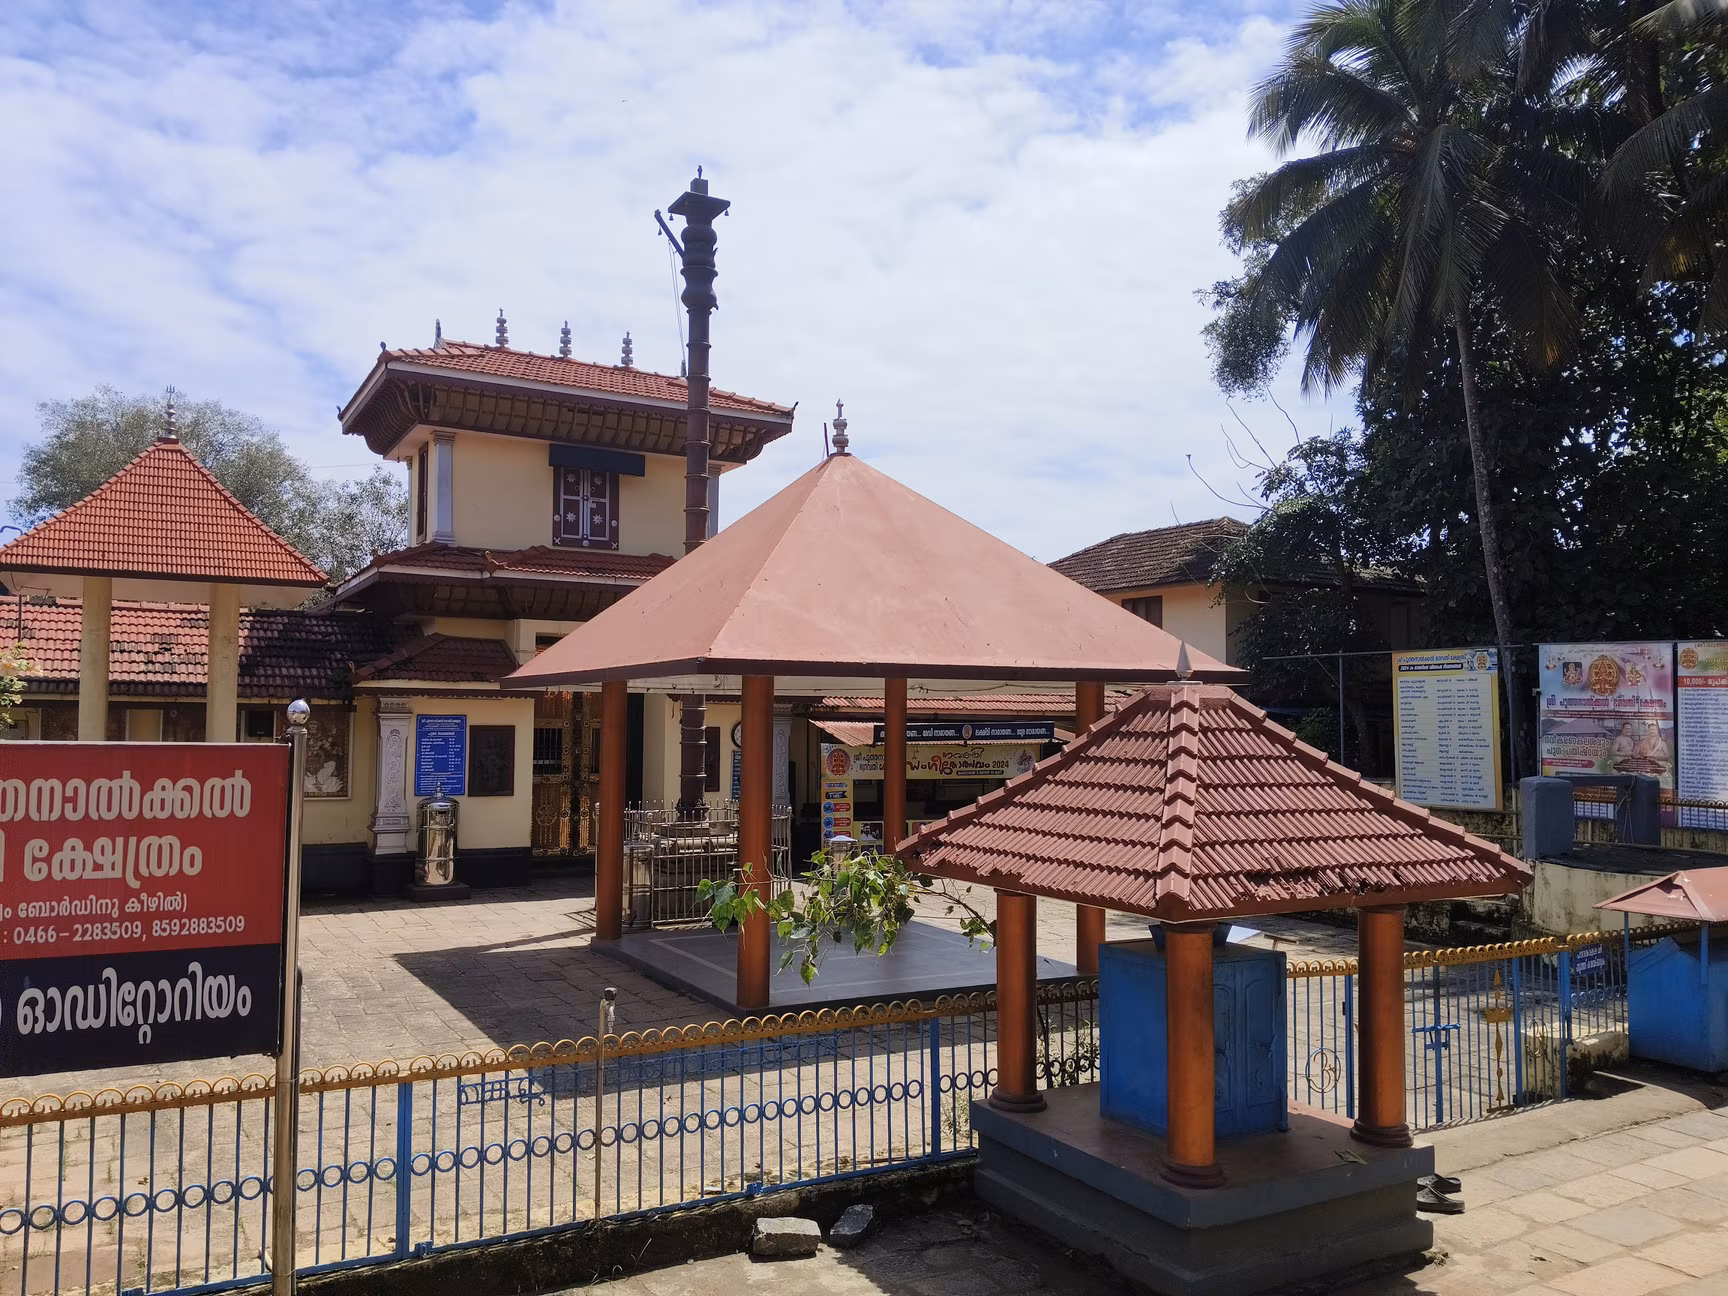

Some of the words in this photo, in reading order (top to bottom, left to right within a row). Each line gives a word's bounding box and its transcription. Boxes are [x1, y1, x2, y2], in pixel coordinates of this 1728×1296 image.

[992, 760, 1009, 769] 2024
[24, 835, 202, 889] ക്ഷേത്രം
[18, 896, 119, 918] ബോർഡിനു
[125, 892, 187, 915] കീഴിൽ)
[152, 915, 245, 937] 8592883509
[16, 961, 252, 1045] ഓഡിറ്റോറിയം
